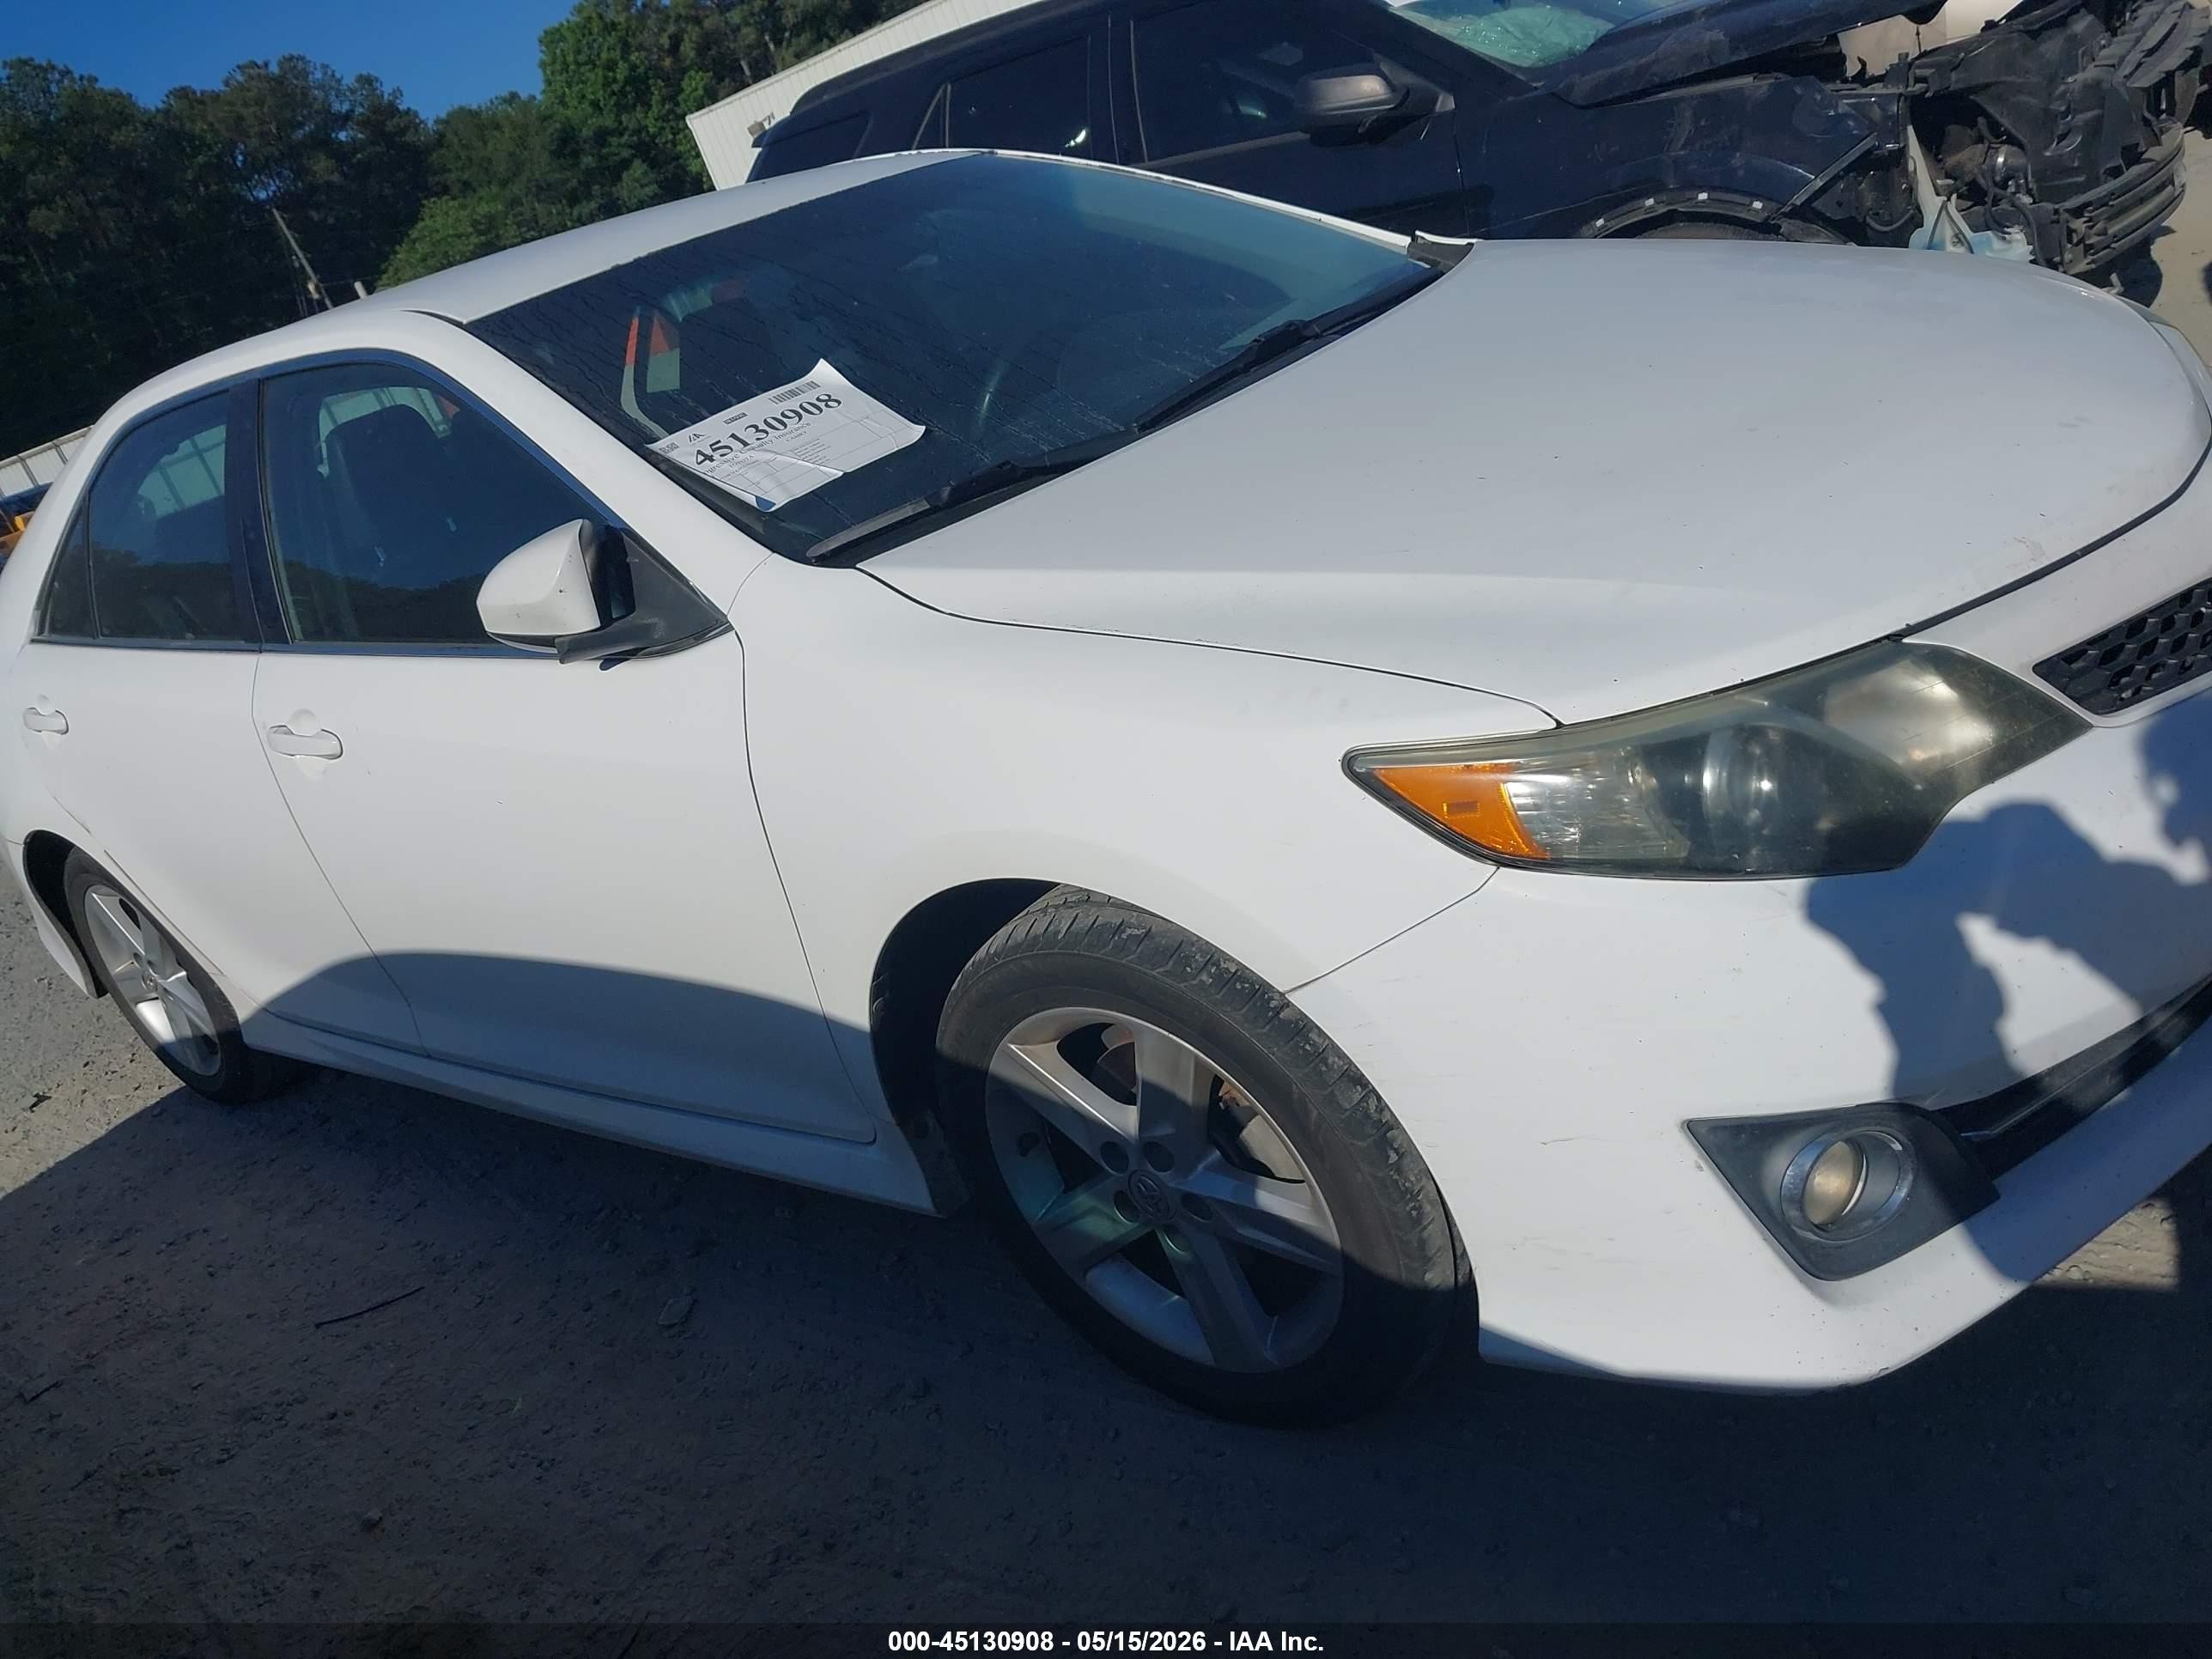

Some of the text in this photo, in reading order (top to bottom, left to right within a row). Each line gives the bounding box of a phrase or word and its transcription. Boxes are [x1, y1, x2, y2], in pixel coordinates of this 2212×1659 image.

[696, 393, 842, 465] 45130908
[774, 422, 811, 440] Insurance
[729, 430, 807, 468] TOYOTA CAMRY
